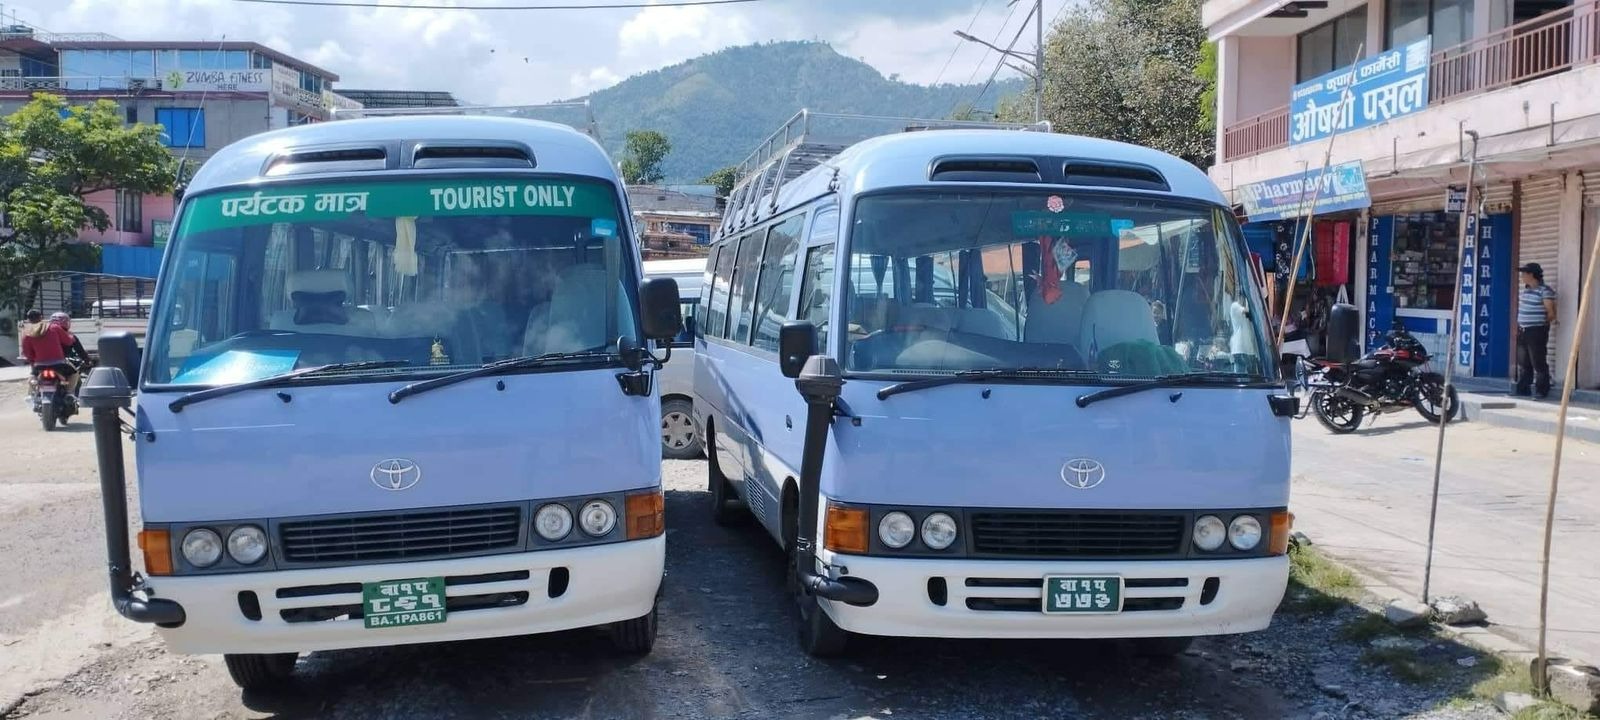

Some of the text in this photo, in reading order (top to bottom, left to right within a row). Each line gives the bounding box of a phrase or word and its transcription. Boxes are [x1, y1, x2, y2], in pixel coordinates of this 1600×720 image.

[186, 71, 225, 83] ZUMBA
[230, 71, 264, 84] FITNESS
[1363, 73, 1426, 120] पसल
[430, 184, 575, 211] TOURIST ONLY
[1253, 171, 1332, 201] Pharmacy
[221, 191, 370, 217] पर्यटक मात्र
[1368, 218, 1379, 345] PHARMACY
[1461, 215, 1475, 364] PHARMACY
[1479, 225, 1493, 356] HARMACY
[370, 611, 442, 626] BA.1PA861
